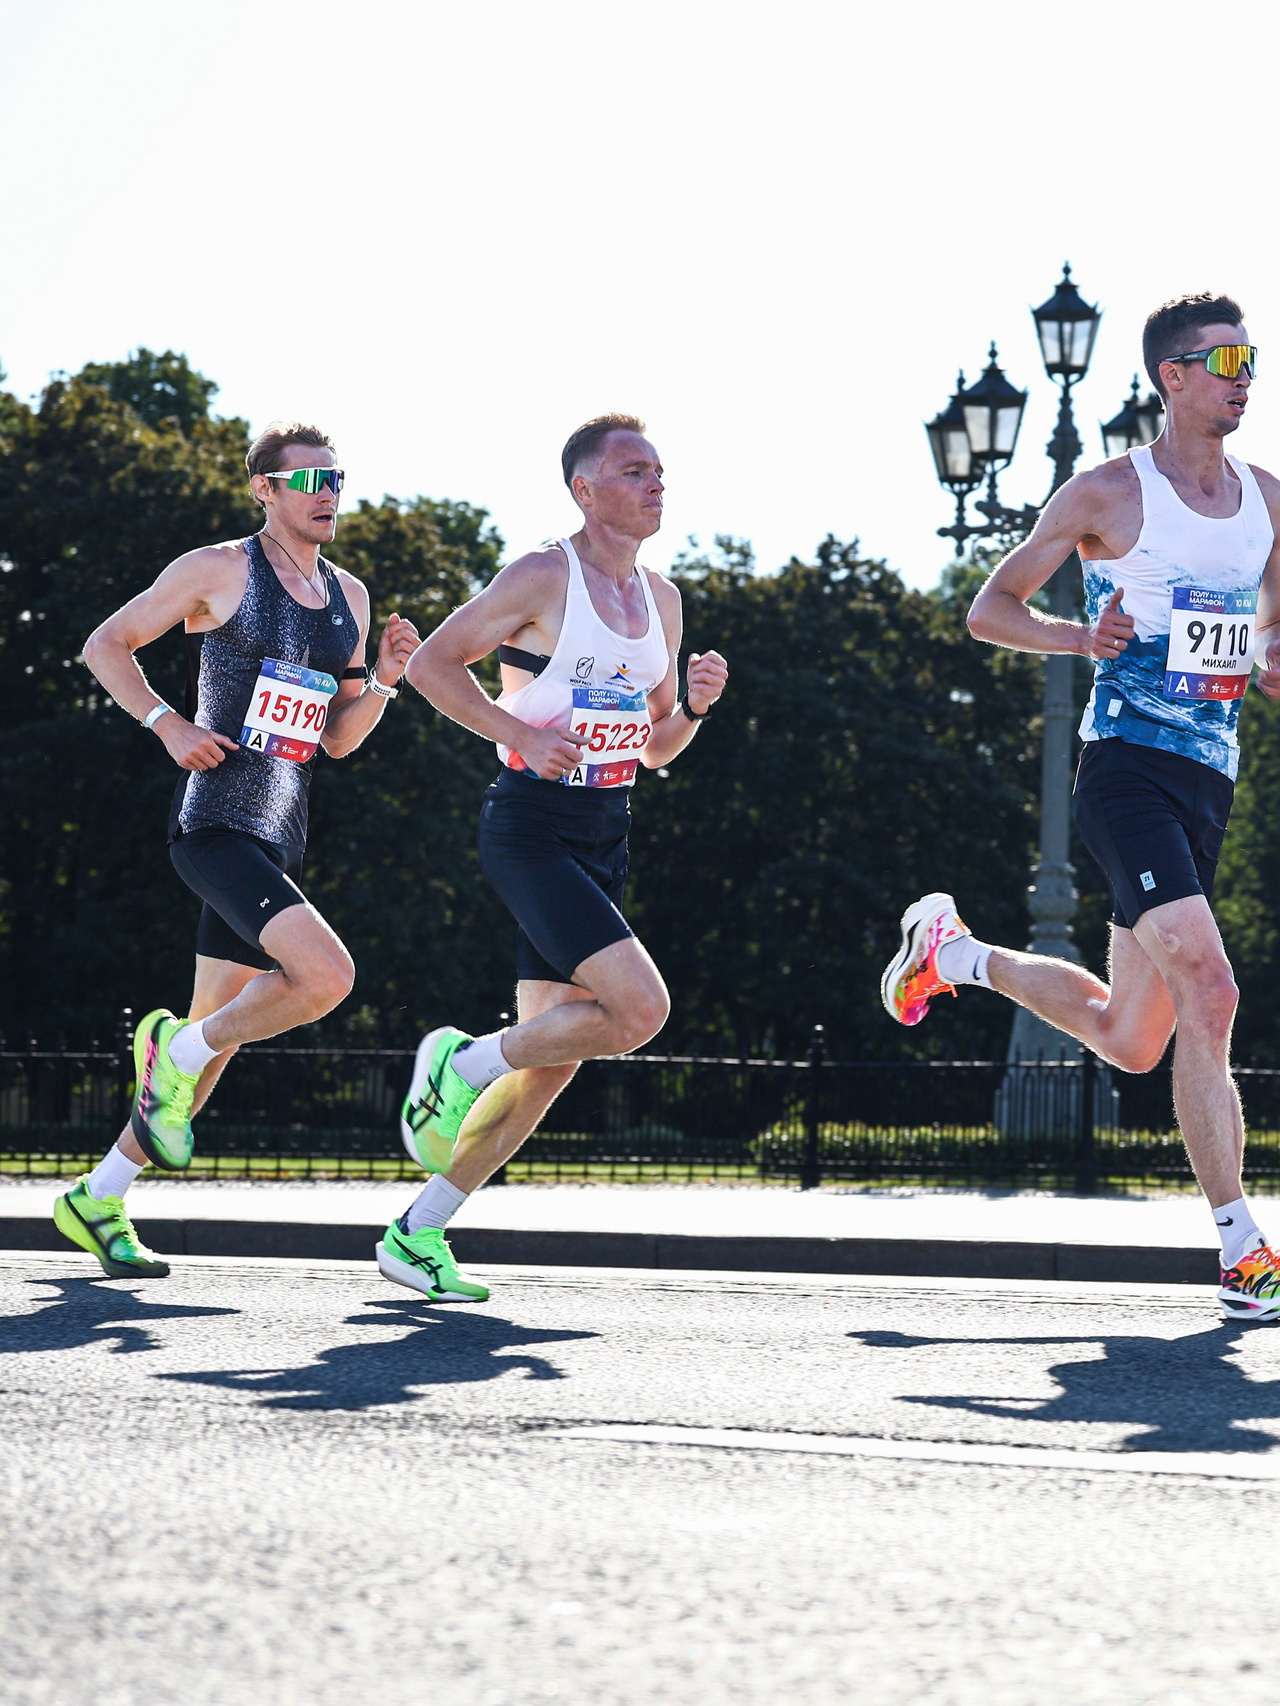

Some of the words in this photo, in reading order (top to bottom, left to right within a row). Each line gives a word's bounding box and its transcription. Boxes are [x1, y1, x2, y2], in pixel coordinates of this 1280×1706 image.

[1189, 590, 1210, 598] ПОЛУ
[1188, 597, 1225, 607] МАРАФОН
[1235, 599, 1243, 607] 10
[1187, 620, 1249, 657] 9110
[1201, 658, 1237, 669] МИХАИЛ
[275, 668, 302, 681] МАРАФОН
[588, 689, 606, 698] ПОЛУ
[588, 696, 620, 705] МАРАФОН
[258, 690, 327, 732] 15190
[574, 722, 651, 753] 15223
